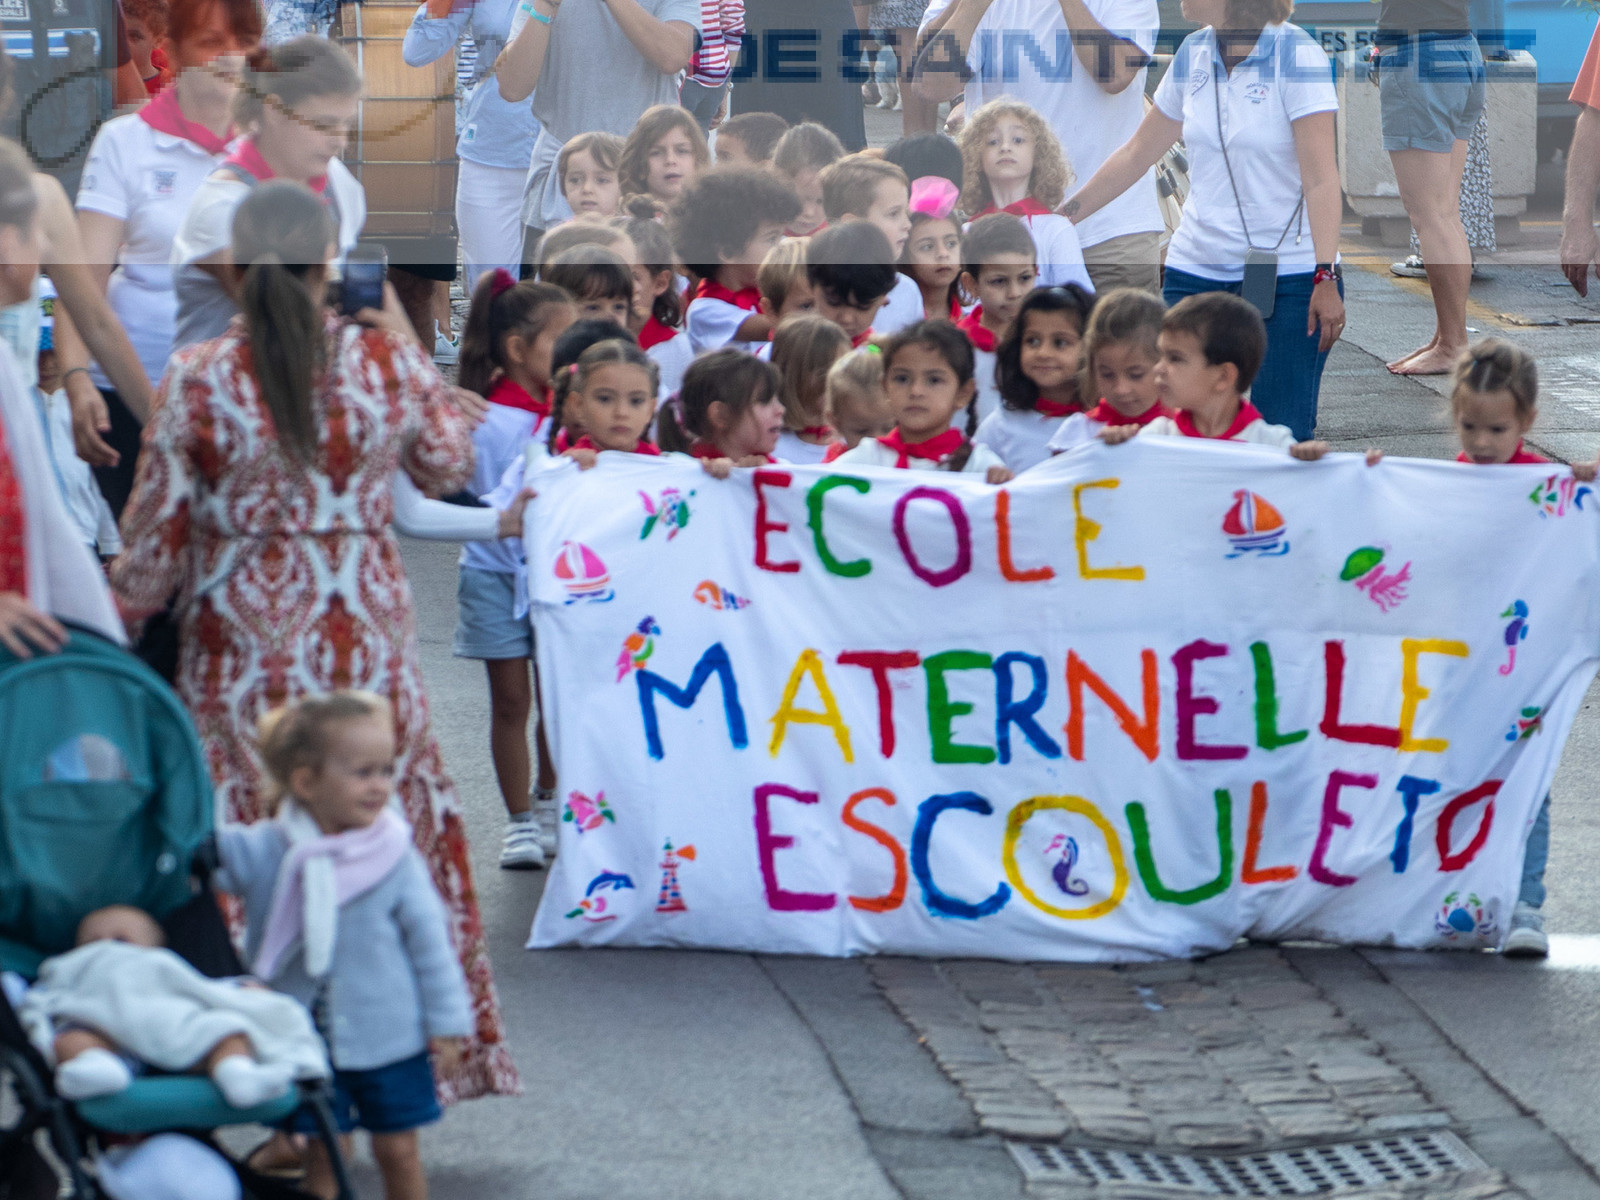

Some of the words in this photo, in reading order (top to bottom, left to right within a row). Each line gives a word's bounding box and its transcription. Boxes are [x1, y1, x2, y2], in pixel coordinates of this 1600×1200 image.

[752, 469, 1146, 588] ECOLE
[636, 636, 1470, 765] MATERNELLE
[752, 770, 1505, 920] ESCOULETO
